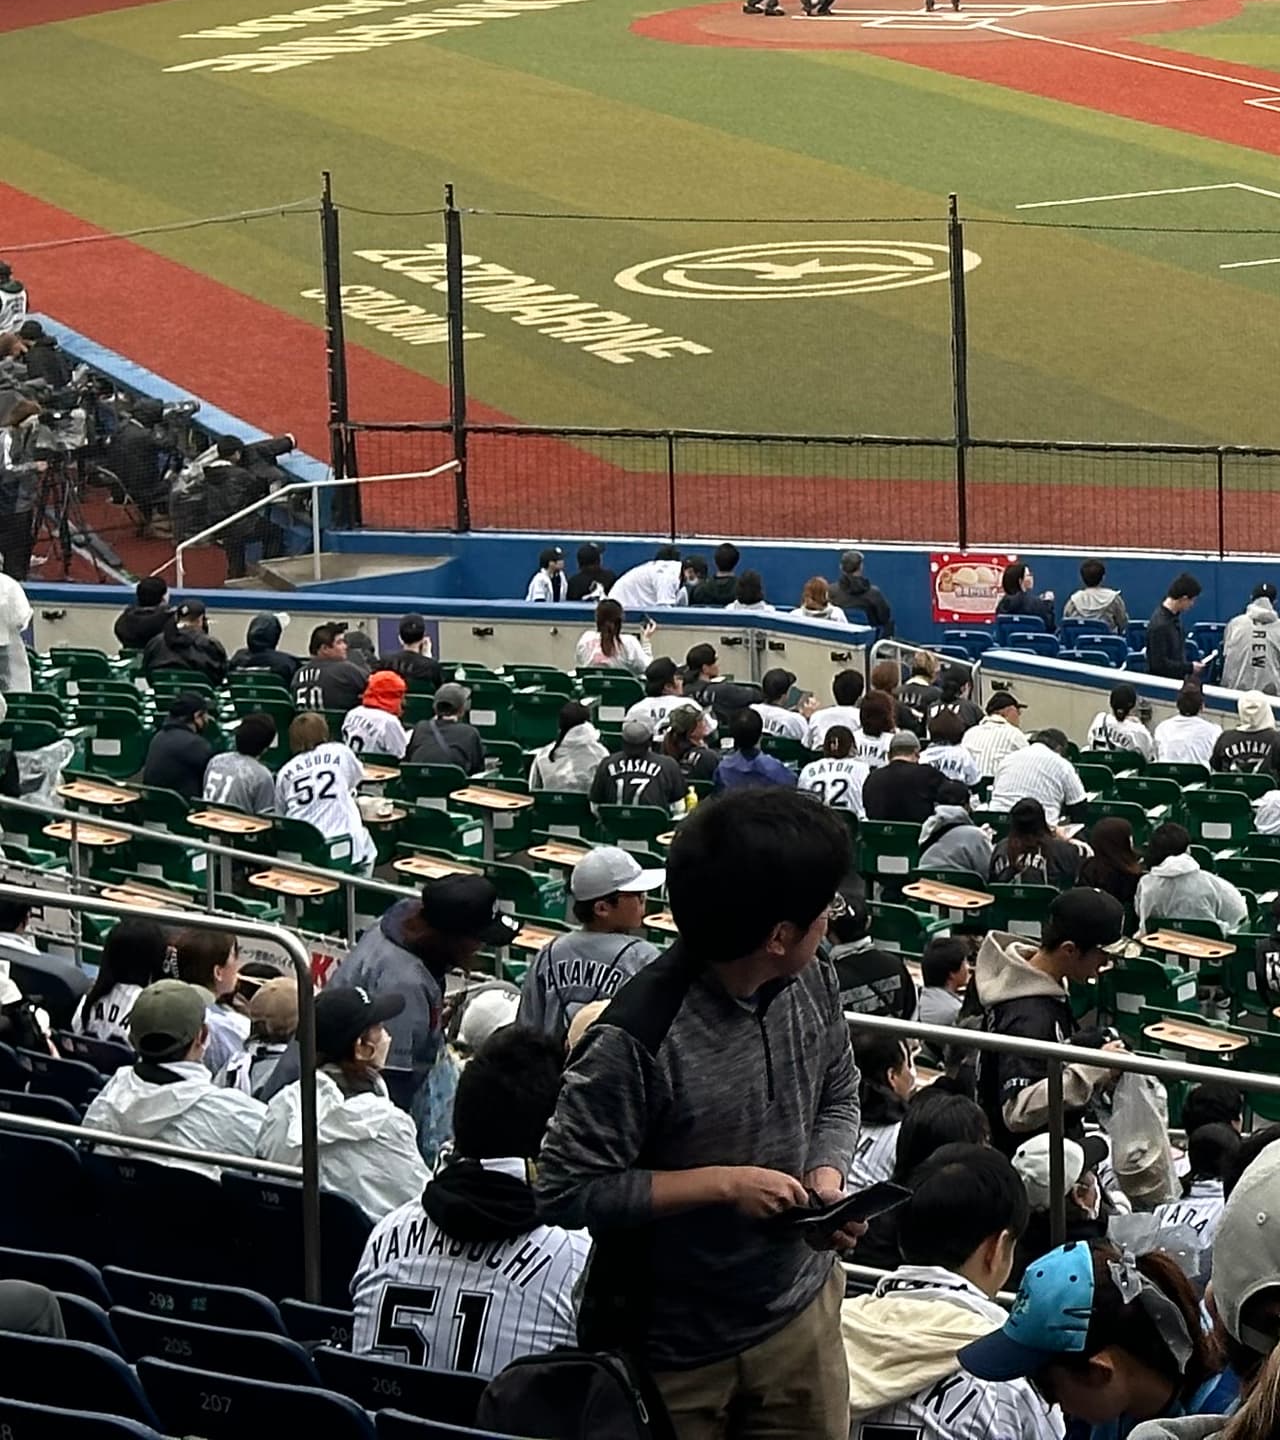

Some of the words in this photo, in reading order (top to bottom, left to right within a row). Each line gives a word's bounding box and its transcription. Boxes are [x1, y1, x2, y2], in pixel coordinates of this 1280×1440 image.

[353, 242, 713, 365] ZOZOMARINE
[607, 758, 662, 778] R.SASAKI
[293, 771, 337, 807] 52
[615, 779, 650, 807] 17
[330, 1322, 354, 1341] 20
[373, 1281, 496, 1376] 51
[371, 1376, 402, 1397] 206
[200, 1391, 233, 1413] 207
